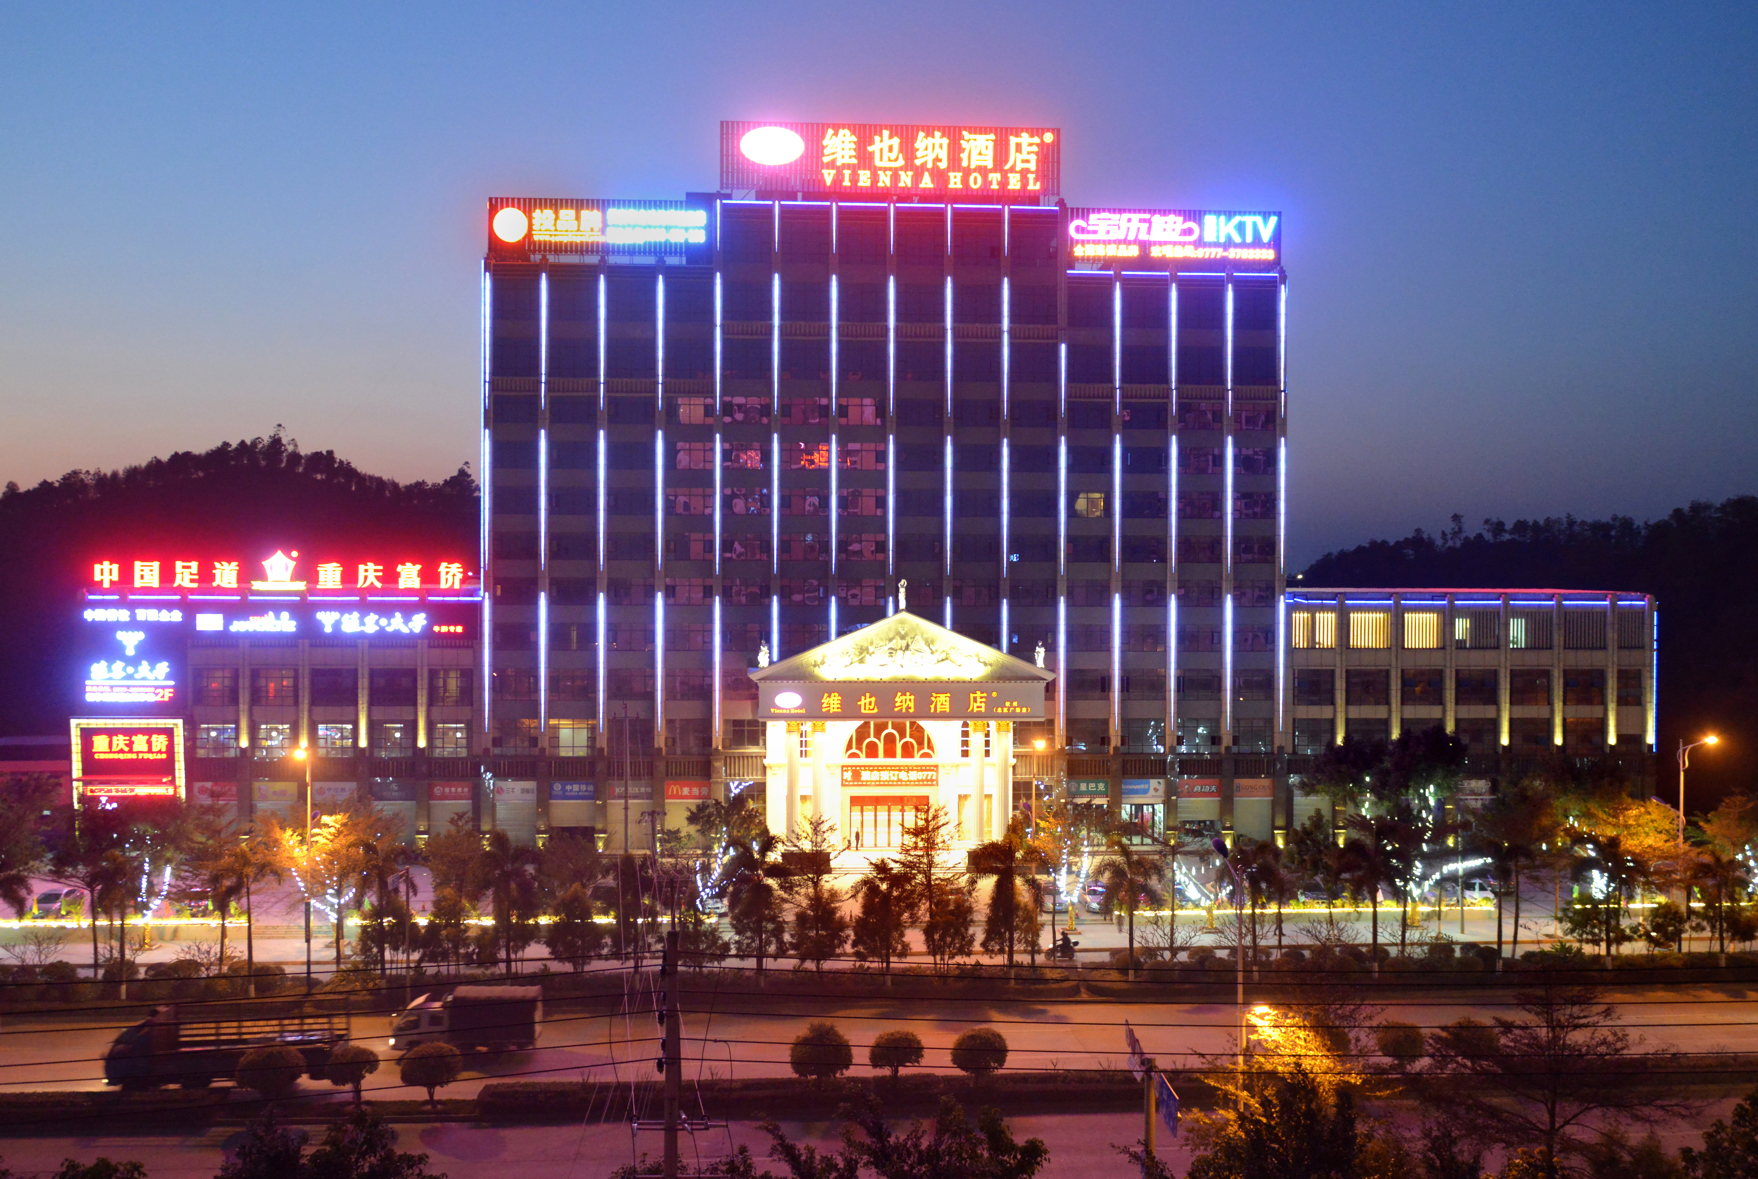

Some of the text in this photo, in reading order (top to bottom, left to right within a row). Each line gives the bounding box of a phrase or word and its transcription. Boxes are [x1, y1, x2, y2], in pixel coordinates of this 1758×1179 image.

[822, 129, 1041, 172] 维也纳酒店
[821, 170, 1041, 190] VIENNA HOTEL
[1218, 215, 1278, 242] KTV
[93, 561, 239, 589] 中国足道
[317, 562, 464, 590] 重庆富侨
[155, 688, 175, 702] 2F
[821, 690, 989, 714] 维也纳酒店
[92, 734, 169, 752] 重庆富侨
[565, 784, 594, 792] 中国移动
[682, 787, 709, 796] 麦当劳
[1079, 782, 1106, 791] 星巴克
[1193, 784, 1218, 793] 真功夫
